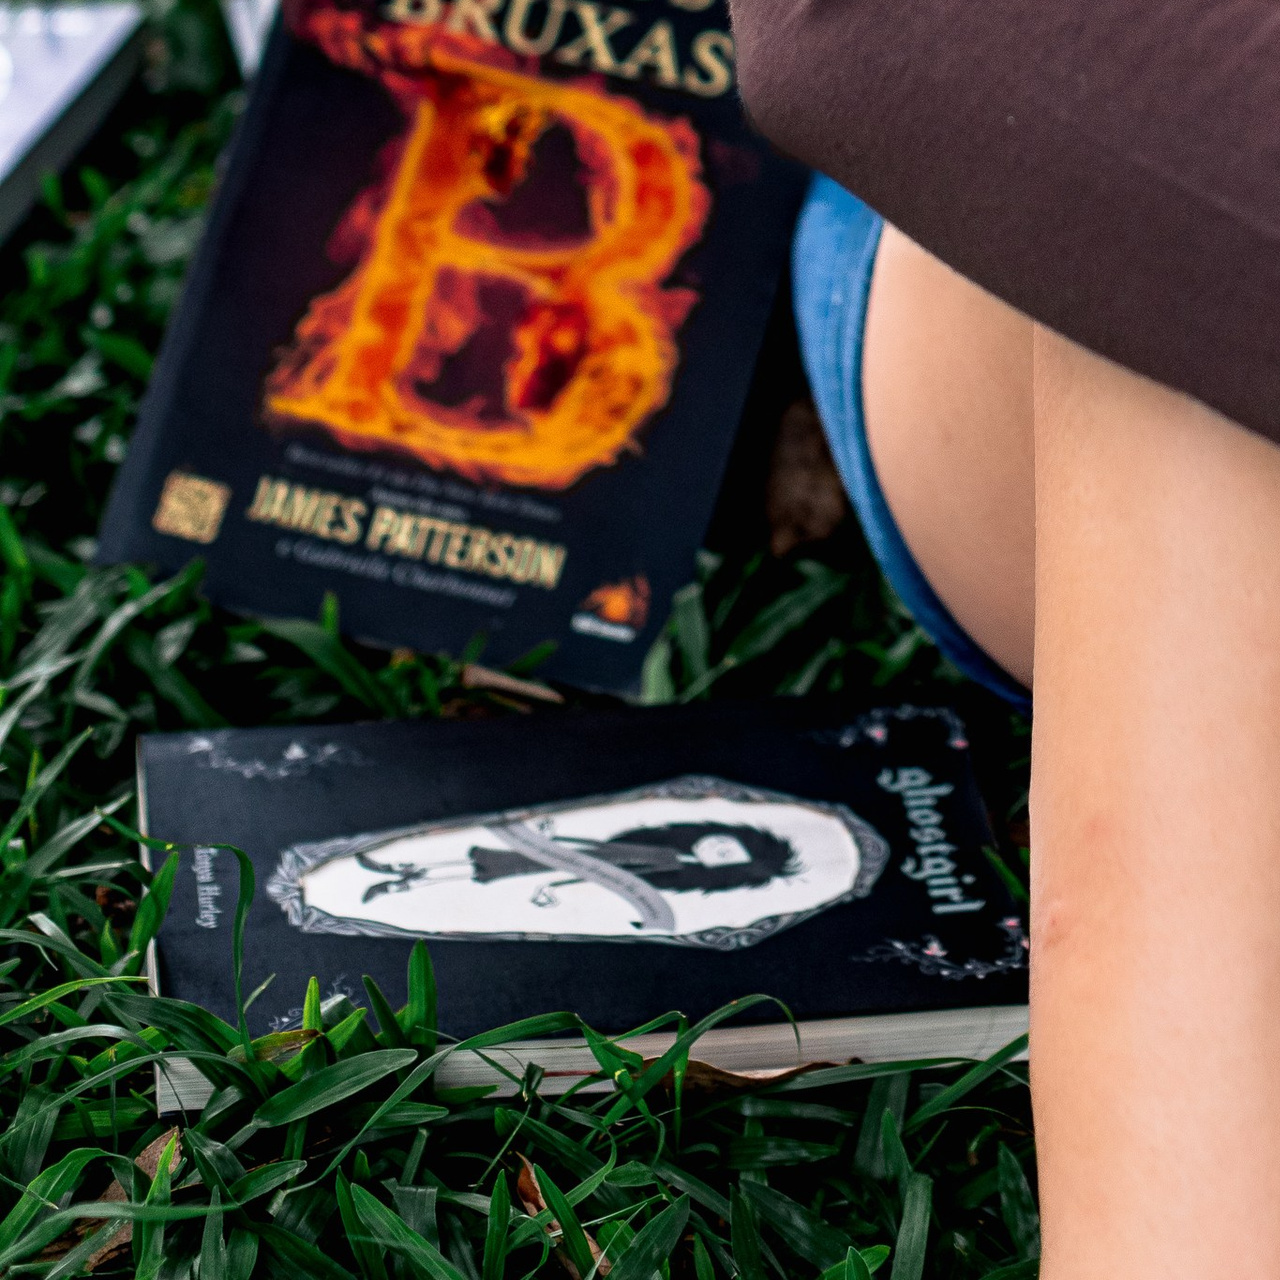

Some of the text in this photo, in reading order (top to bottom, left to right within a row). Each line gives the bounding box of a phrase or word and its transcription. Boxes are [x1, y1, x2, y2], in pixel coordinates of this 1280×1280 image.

[246, 474, 368, 548] JAMES
[366, 504, 568, 592] PATTERSON
[875, 766, 987, 915] ghostgirl
[195, 883, 223, 929] Hurley
